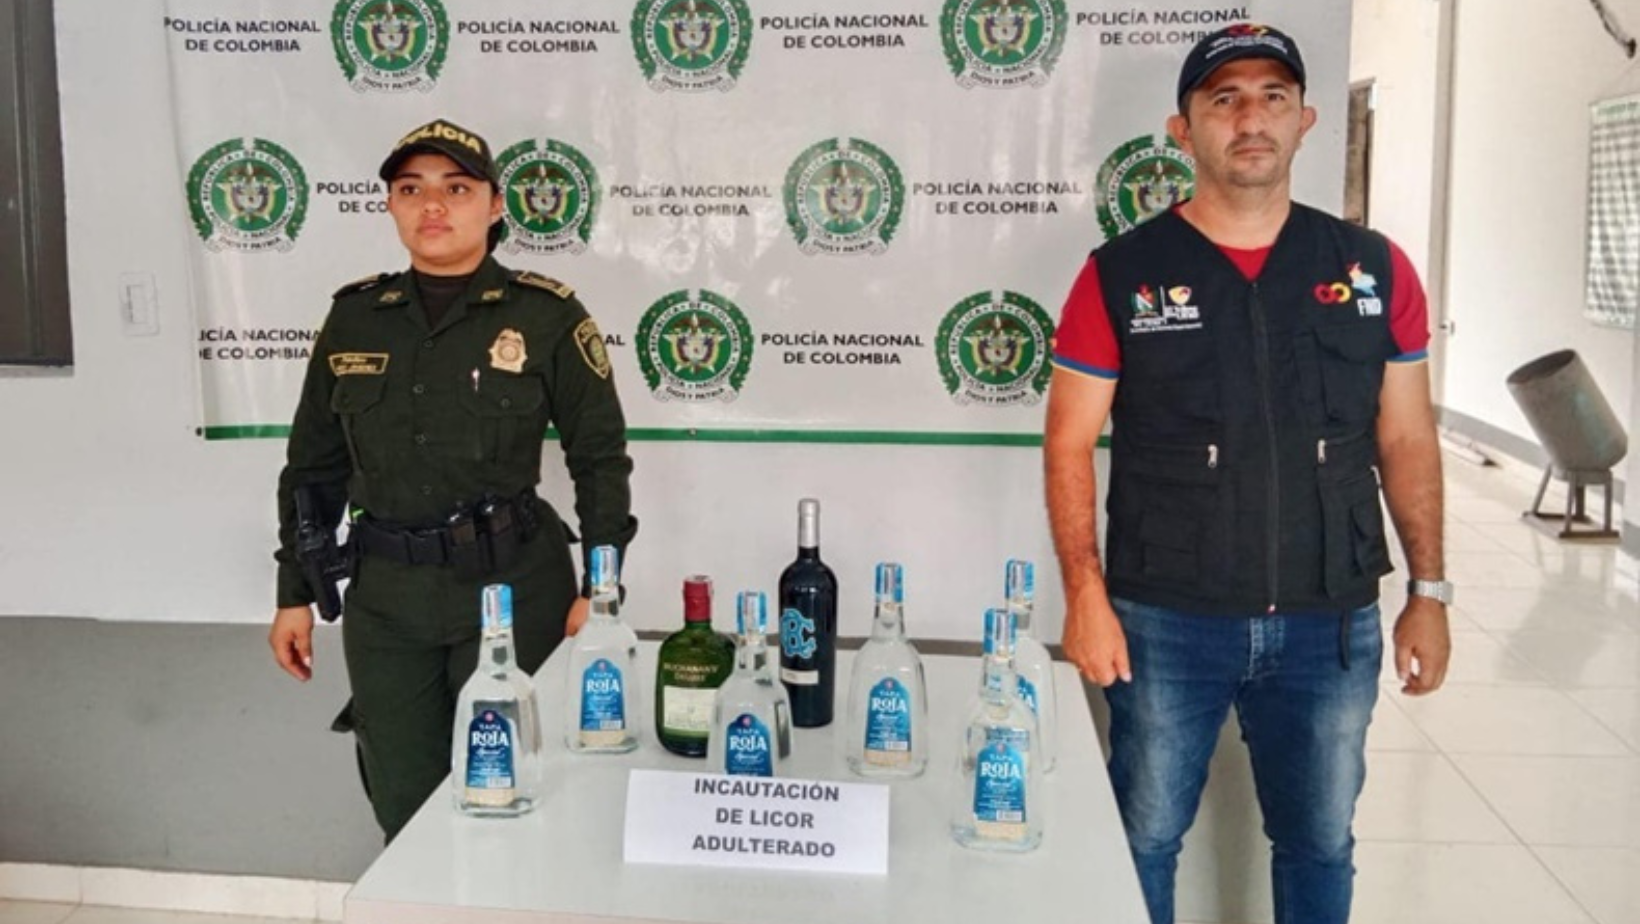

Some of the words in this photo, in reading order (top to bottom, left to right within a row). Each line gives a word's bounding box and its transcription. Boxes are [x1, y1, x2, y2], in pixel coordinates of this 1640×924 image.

[760, 13, 830, 30] POLICÍA
[834, 14, 929, 28] NACIONAL
[1076, 9, 1148, 25] POLICÍA
[1154, 7, 1249, 24] NACIONAL
[236, 20, 321, 33] NACIONAL
[457, 19, 525, 34] POLICÍA
[529, 20, 620, 34] NACIONAL
[185, 39, 208, 52] DE
[213, 39, 301, 52] COLOMBIA
[480, 40, 504, 53] DE
[506, 39, 598, 53] COLOMBIA
[783, 35, 806, 49] DE
[811, 34, 905, 48] COLOMBIA
[1100, 31, 1123, 46] DE
[1127, 31, 1206, 45] COLOMB
[317, 180, 381, 194] POLICÍA
[681, 185, 772, 198] NACIONAL
[913, 179, 983, 195] POLICÍA
[988, 181, 1082, 195] NACIONAL
[339, 201, 360, 212] DE
[632, 204, 655, 216] DE
[659, 204, 749, 216] COLOMBIA
[936, 201, 958, 214] DE
[963, 201, 1057, 214] COLOMBIA
[761, 331, 829, 346] POLICÍA
[833, 334, 924, 347] NACIONAL
[217, 347, 310, 360] COLOMBIA
[783, 351, 805, 364] DE
[809, 351, 901, 365] COLOMBIA
[587, 679, 620, 693] ROJA
[871, 697, 907, 713] ROJA
[471, 731, 509, 747] ROJA
[729, 735, 767, 752] ROJA
[980, 762, 1021, 779] ROJA
[694, 778, 839, 801] INCAUTACIÓN
[715, 808, 743, 825] DE
[750, 809, 814, 829] LICOR
[692, 835, 836, 857] ADULTERADO
